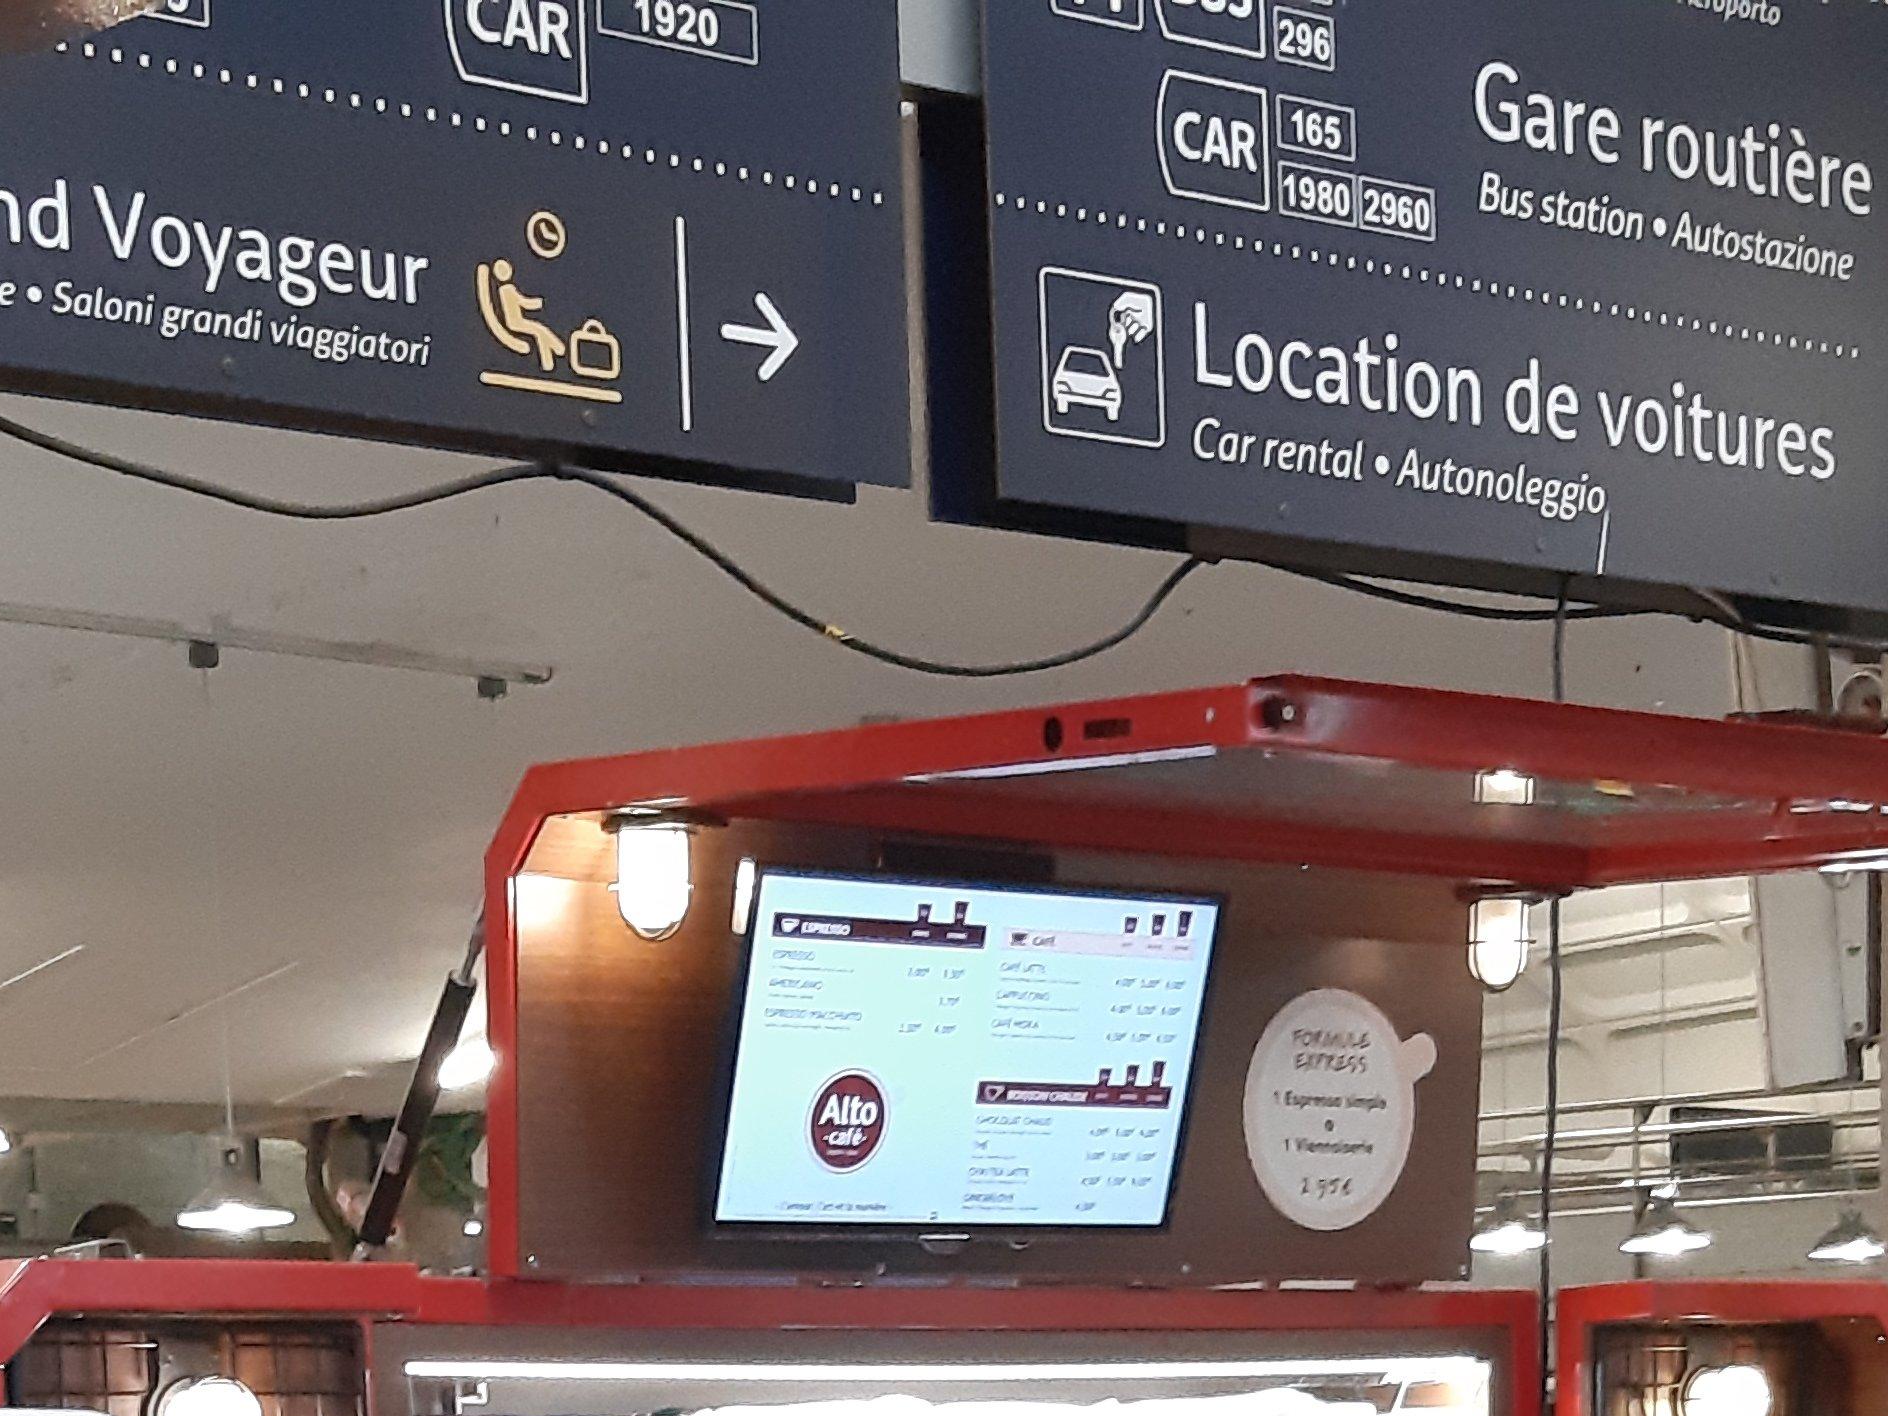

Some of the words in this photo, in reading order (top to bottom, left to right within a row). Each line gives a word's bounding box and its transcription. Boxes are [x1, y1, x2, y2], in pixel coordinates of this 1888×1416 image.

[635, 0, 718, 46] 1920
[1278, 19, 1331, 62] 296
[1174, 112, 1257, 172] CAR
[1291, 109, 1341, 149] 165
[1475, 62, 1618, 163] Gare
[1643, 117, 1872, 214] routière
[1281, 174, 1351, 219] 1980
[1364, 189, 1429, 231] 2960
[1479, 172, 1534, 219] Bus
[1540, 191, 1643, 240] station
[1671, 212, 1853, 280] Autostazione
[94, 184, 430, 307] Voyageur
[52, 282, 154, 325] Saloni
[161, 306, 262, 340] grandi
[271, 315, 431, 365] viaggiatori
[1193, 298, 1482, 426] Location
[1506, 358, 1578, 439] de
[1598, 382, 1834, 479] voitures
[1194, 418, 1256, 463] Car
[1264, 439, 1363, 480] rental
[1395, 447, 1607, 521] Autonoleggio
[818, 1093, 879, 1126] Alto
